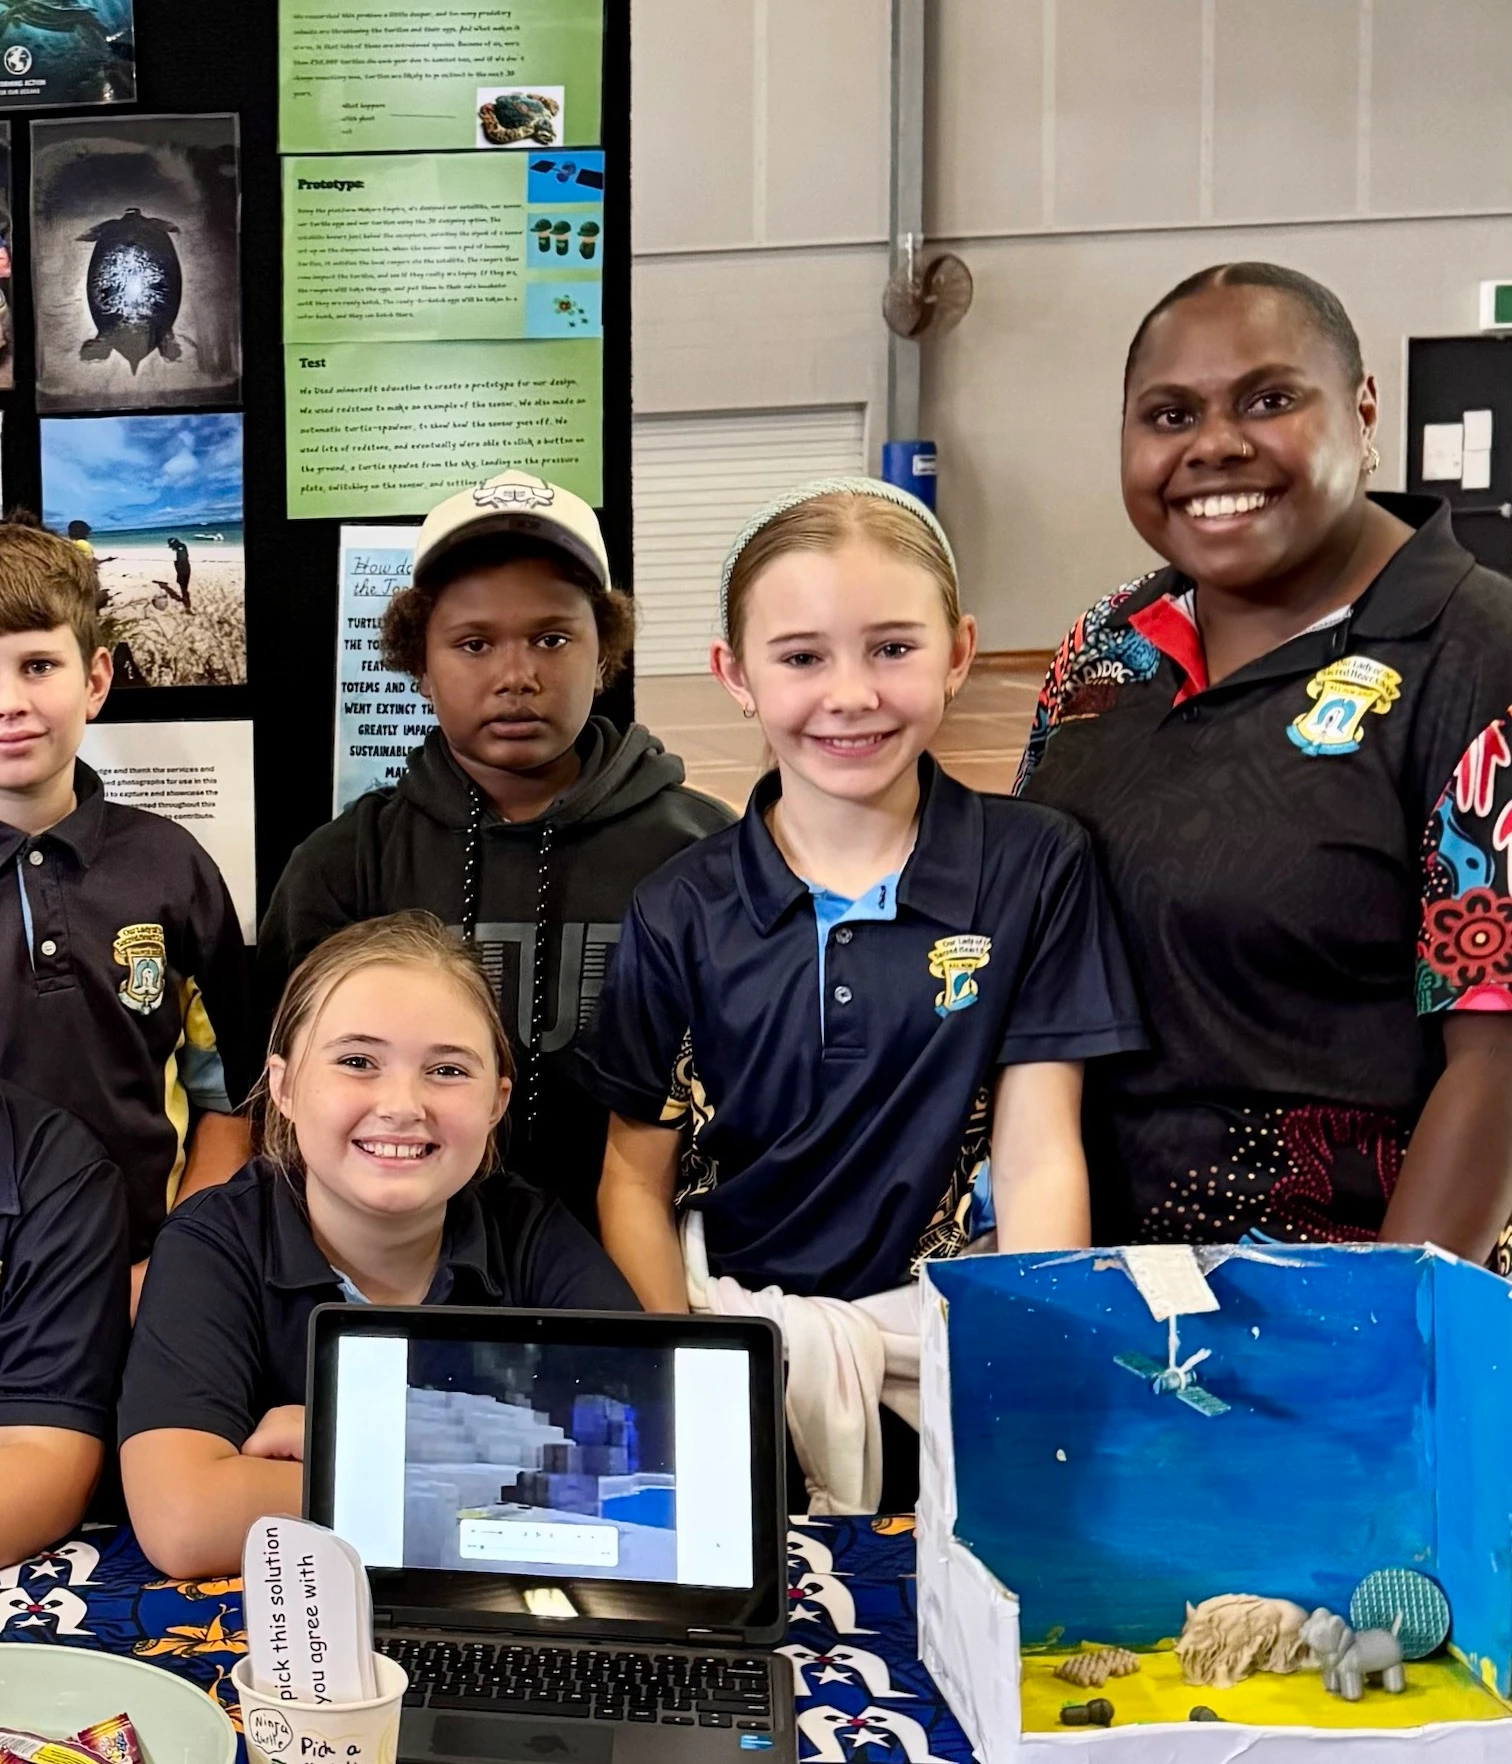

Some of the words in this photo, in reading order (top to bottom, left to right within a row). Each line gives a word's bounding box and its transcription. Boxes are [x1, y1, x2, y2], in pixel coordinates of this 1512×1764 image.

[298, 357, 327, 369] Test
[299, 387, 312, 395] We
[336, 384, 378, 394] minecraft
[380, 383, 421, 393] education
[424, 383, 433, 391] to
[434, 382, 462, 391] create
[471, 380, 514, 392] prototype
[517, 379, 531, 388] for
[299, 406, 312, 414] We
[314, 406, 334, 414] used
[336, 404, 373, 414] redstone
[387, 403, 409, 413] make
[423, 401, 457, 412] example
[459, 401, 468, 409] of
[471, 400, 486, 408] the
[519, 398, 531, 407] We
[534, 398, 550, 406] also
[552, 397, 574, 405] made
[300, 425, 341, 434] automatic
[419, 422, 428, 430] to
[430, 421, 450, 430] show
[452, 420, 469, 429] how
[471, 420, 486, 428] the
[488, 420, 513, 428] sensor
[516, 418, 534, 429] goes
[555, 416, 568, 425] We
[353, 556, 392, 575] How
[353, 578, 377, 596] the
[344, 639, 362, 650] THE
[341, 681, 380, 693] TOTEMS
[384, 681, 406, 693] AND
[344, 702, 372, 715] WENT
[376, 703, 417, 715] EXTINCT
[358, 724, 399, 736] GREATLY
[117, 779, 165, 787] photographs
[119, 790, 149, 799] capture
[166, 789, 204, 797] showcase
[158, 801, 200, 809] throughout
[264, 1527, 285, 1606] solution
[297, 1554, 317, 1599] with
[269, 1613, 288, 1653] this
[304, 1605, 328, 1663] agree
[272, 1659, 298, 1700] pick
[313, 1672, 333, 1705] you
[346, 1744, 362, 1756] a
